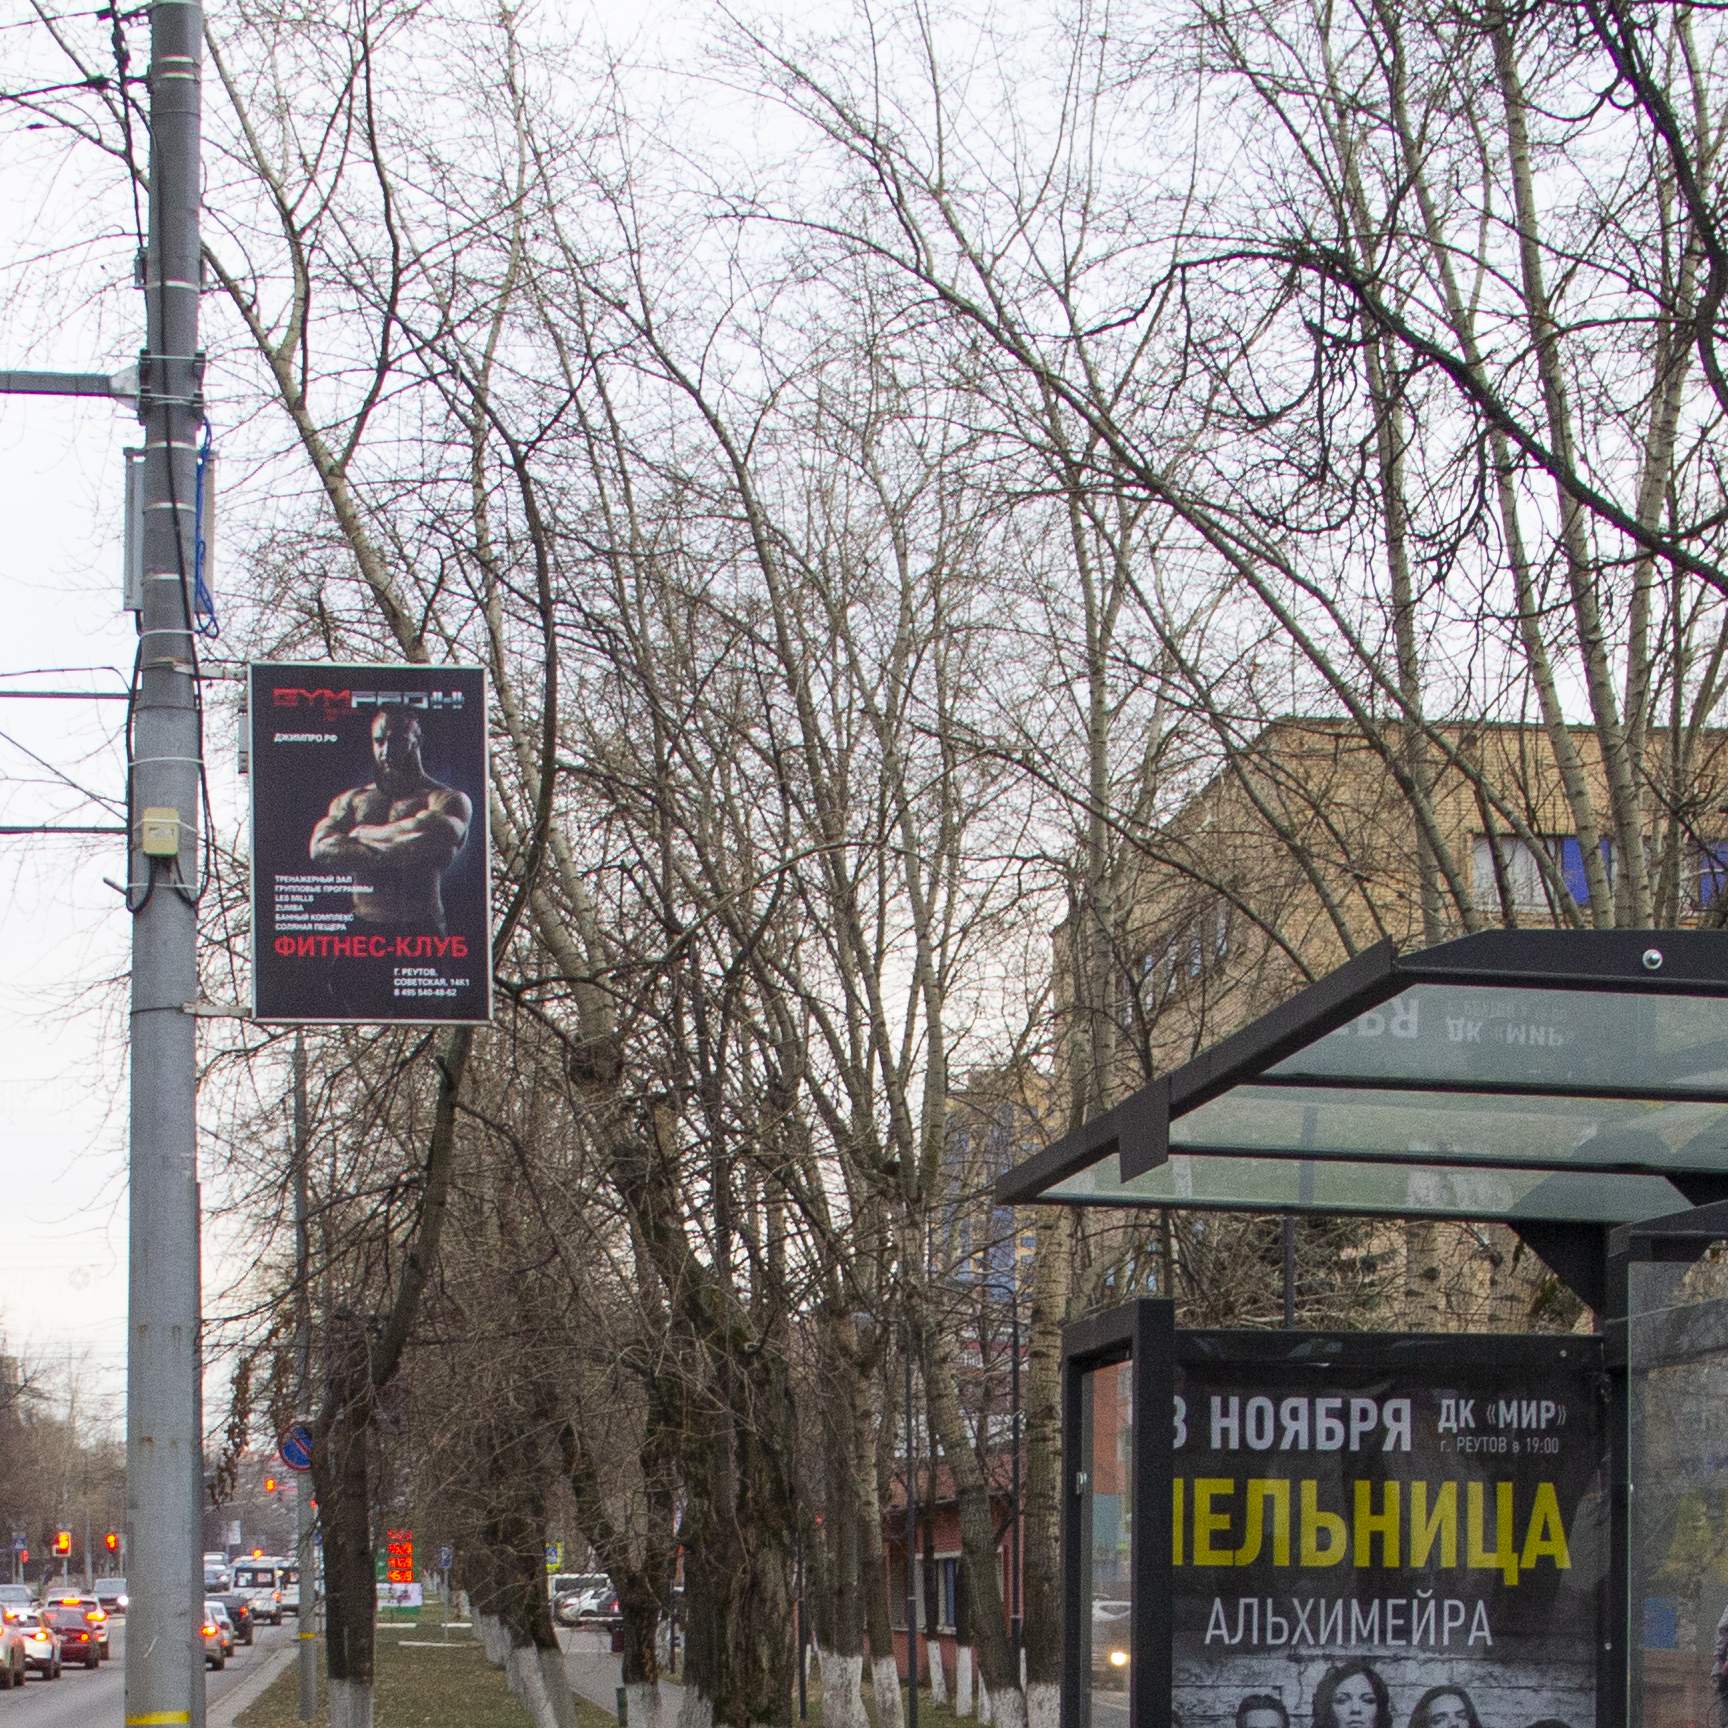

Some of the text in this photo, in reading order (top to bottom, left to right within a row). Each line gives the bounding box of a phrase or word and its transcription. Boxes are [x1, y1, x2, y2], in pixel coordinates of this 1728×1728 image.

[274, 936, 468, 957] ФИТНЕС-КЛУБ
[1210, 1396, 1412, 1452] НОЯБРЯ
[1438, 1398, 1476, 1433] ДК
[1487, 1399, 1566, 1429] «МИР»
[1457, 1437, 1506, 1453] РЕУТОВ
[1512, 1442, 1520, 1453] в
[1526, 1438, 1559, 1453] 19:00
[1204, 1589, 1493, 1647] АЛЬХИМЕЙРА
